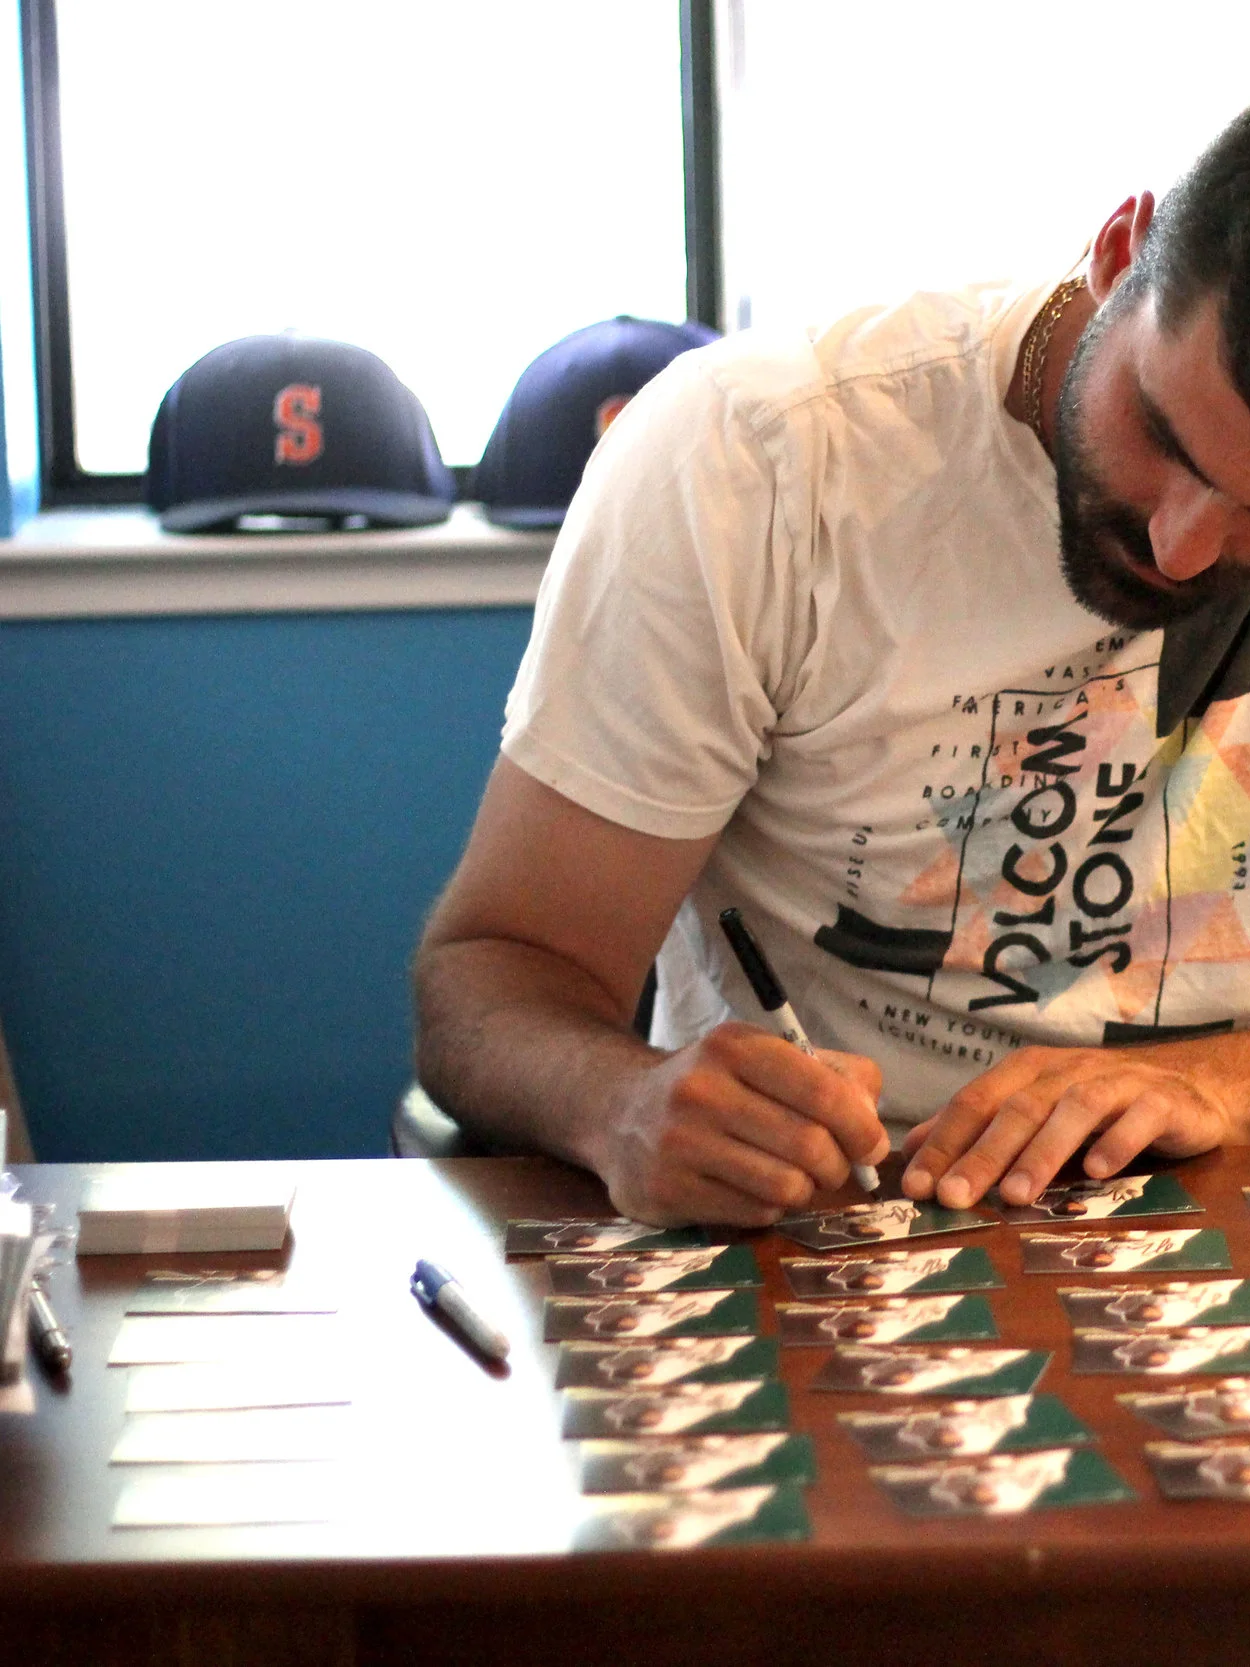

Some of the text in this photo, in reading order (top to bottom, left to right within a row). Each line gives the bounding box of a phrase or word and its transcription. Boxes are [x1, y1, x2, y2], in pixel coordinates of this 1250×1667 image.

[274, 383, 324, 466] S
[922, 774, 1067, 799] BOADIN
[968, 711, 1088, 1012] VOLCOM
[859, 999, 1022, 1049] A NEW YOUTH
